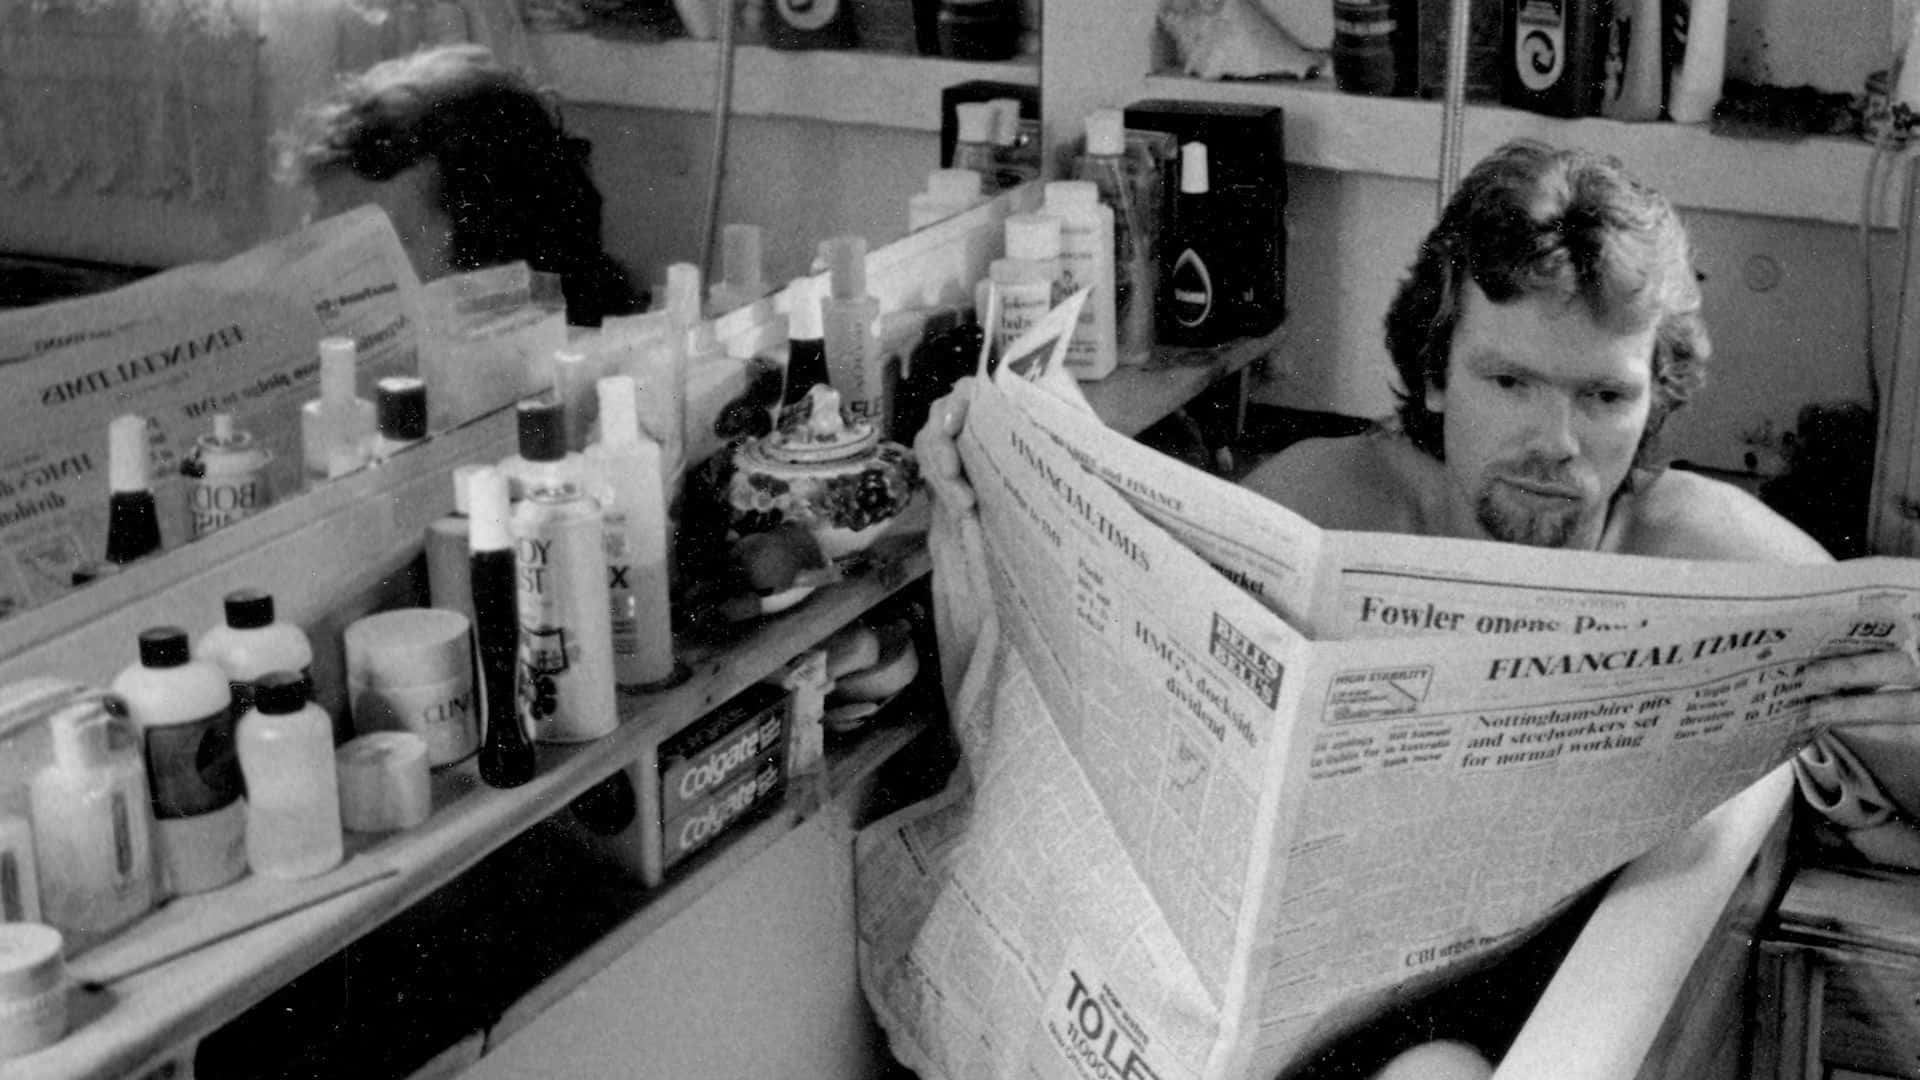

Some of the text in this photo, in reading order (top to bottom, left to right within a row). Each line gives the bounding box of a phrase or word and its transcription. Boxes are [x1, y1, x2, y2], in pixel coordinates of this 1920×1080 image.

[1011, 430, 1096, 525] FINANCIAL
[1098, 515, 1151, 572] TIMES
[1360, 596, 1465, 631] Fowler
[1487, 626, 1792, 682] FINANCIAL TIMES
[1165, 676, 1226, 743] dividend
[1196, 677, 1258, 749] dockside
[1467, 714, 1660, 750] and steelworkers set
[1478, 696, 1673, 730] Nottinghamshire pits
[679, 731, 760, 800] Colgate
[1461, 732, 1645, 770] for normal working
[1066, 969, 1104, 1041] TO
